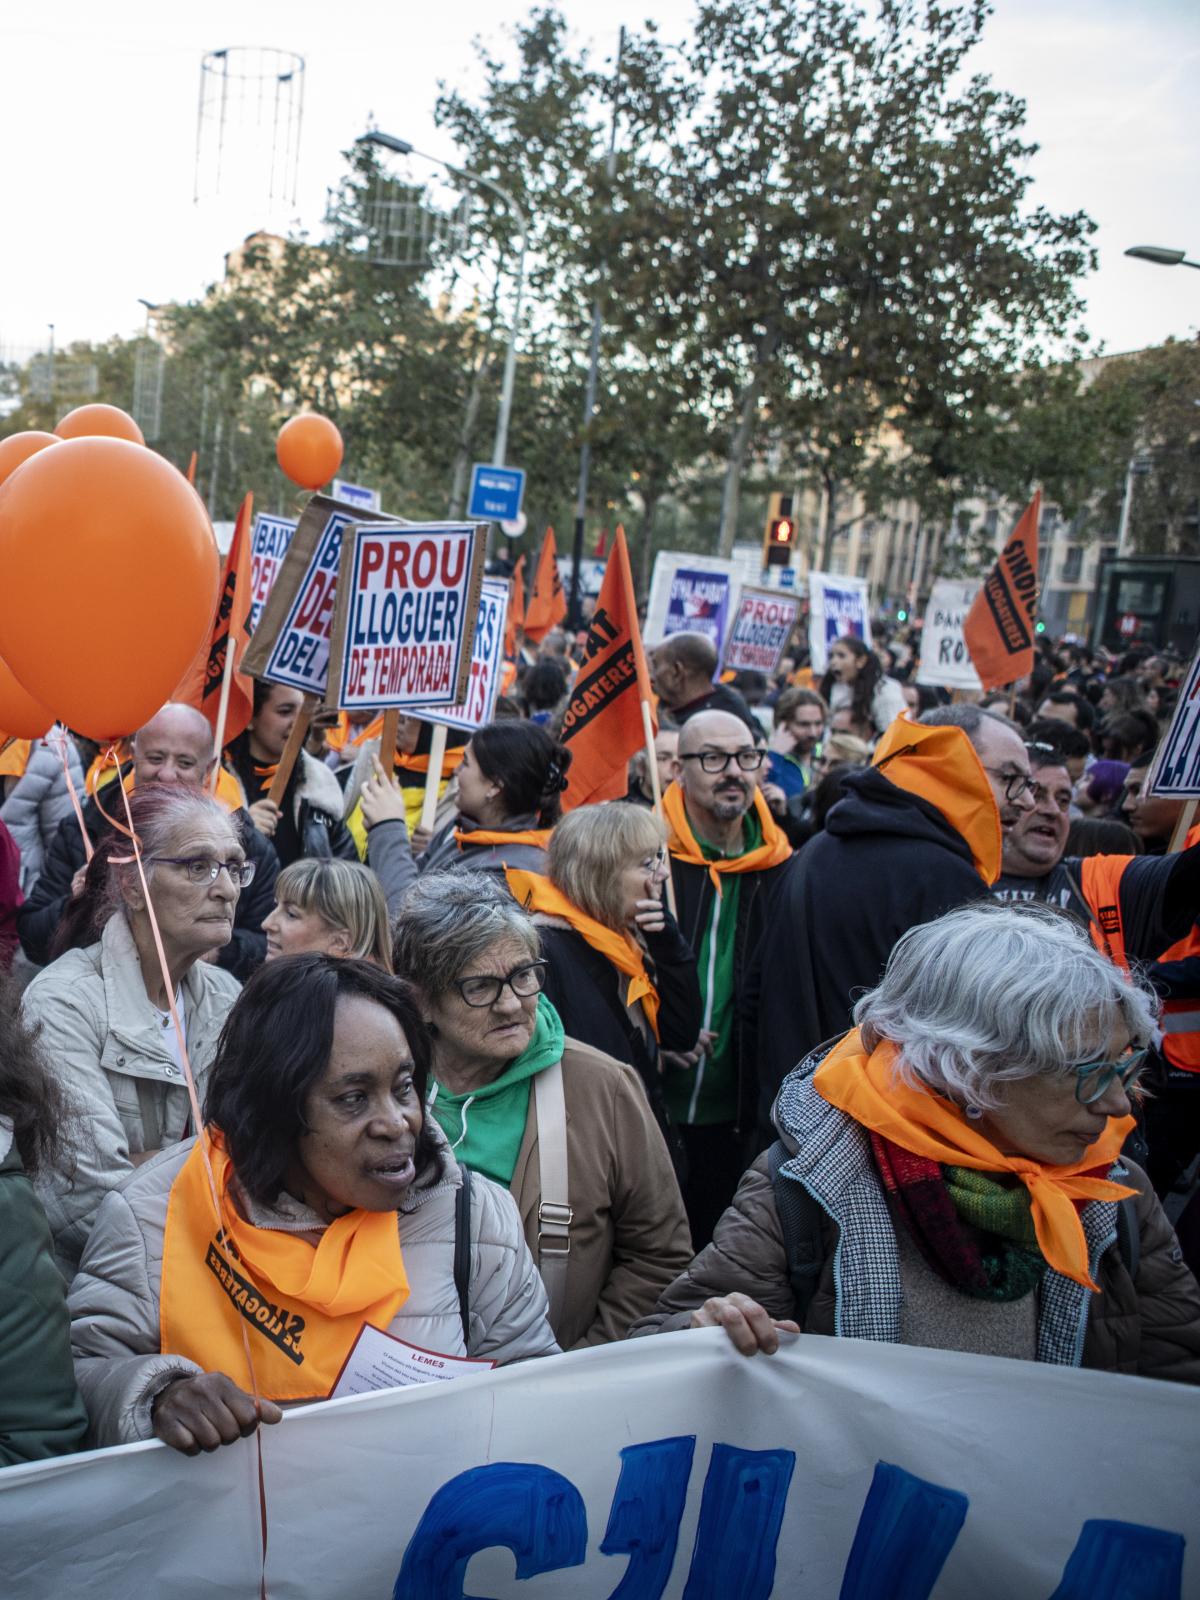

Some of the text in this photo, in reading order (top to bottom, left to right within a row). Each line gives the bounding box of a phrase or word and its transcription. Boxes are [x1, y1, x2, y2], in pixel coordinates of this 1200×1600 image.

[359, 539, 467, 591] PROU
[354, 590, 459, 645] LLOGUER
[742, 600, 795, 625] PROU
[276, 631, 320, 678] DEL
[348, 648, 369, 697] DE
[371, 645, 452, 696] TEMPORADA
[411, 1353, 446, 1369] LEMES
